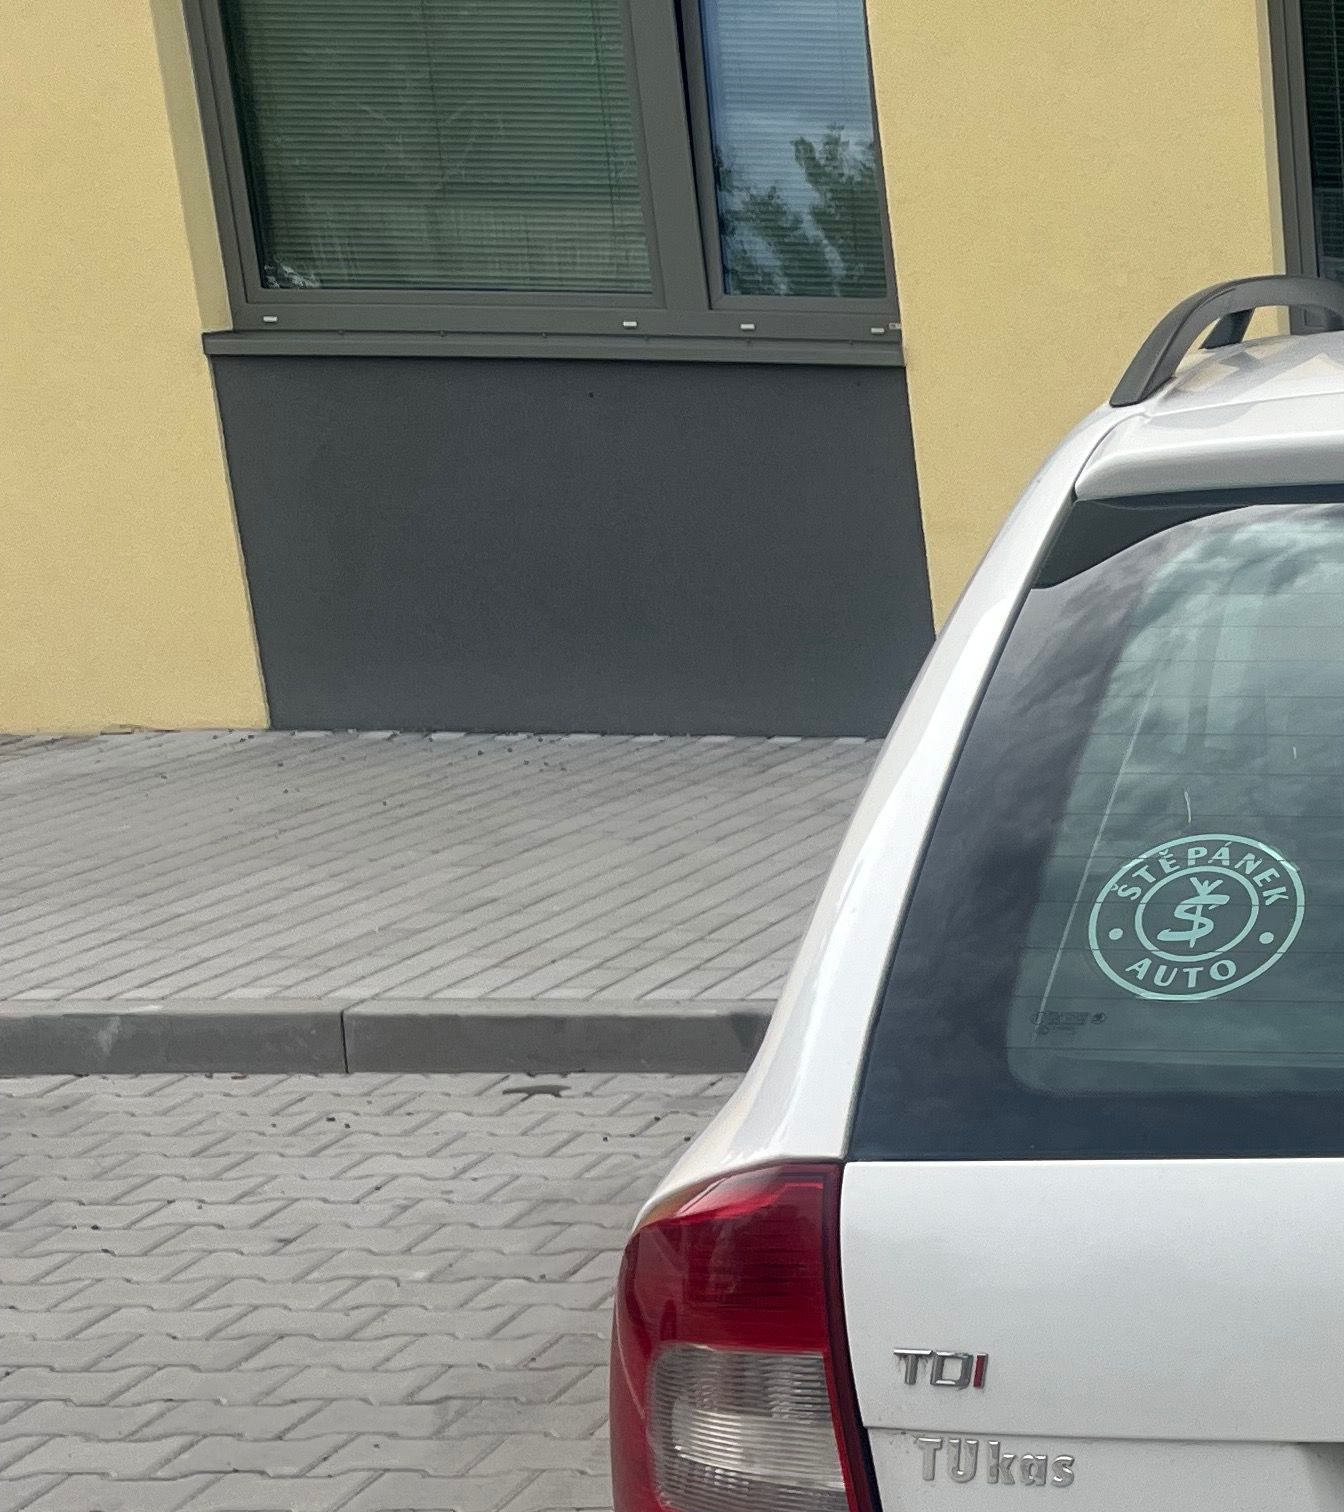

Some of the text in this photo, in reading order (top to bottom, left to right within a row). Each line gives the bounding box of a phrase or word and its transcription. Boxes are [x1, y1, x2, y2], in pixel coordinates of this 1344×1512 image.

[1111, 842, 1289, 906] ŠTĚPÁNEK
[1125, 958, 1237, 988] AUTO
[893, 1347, 988, 1389] TDI
